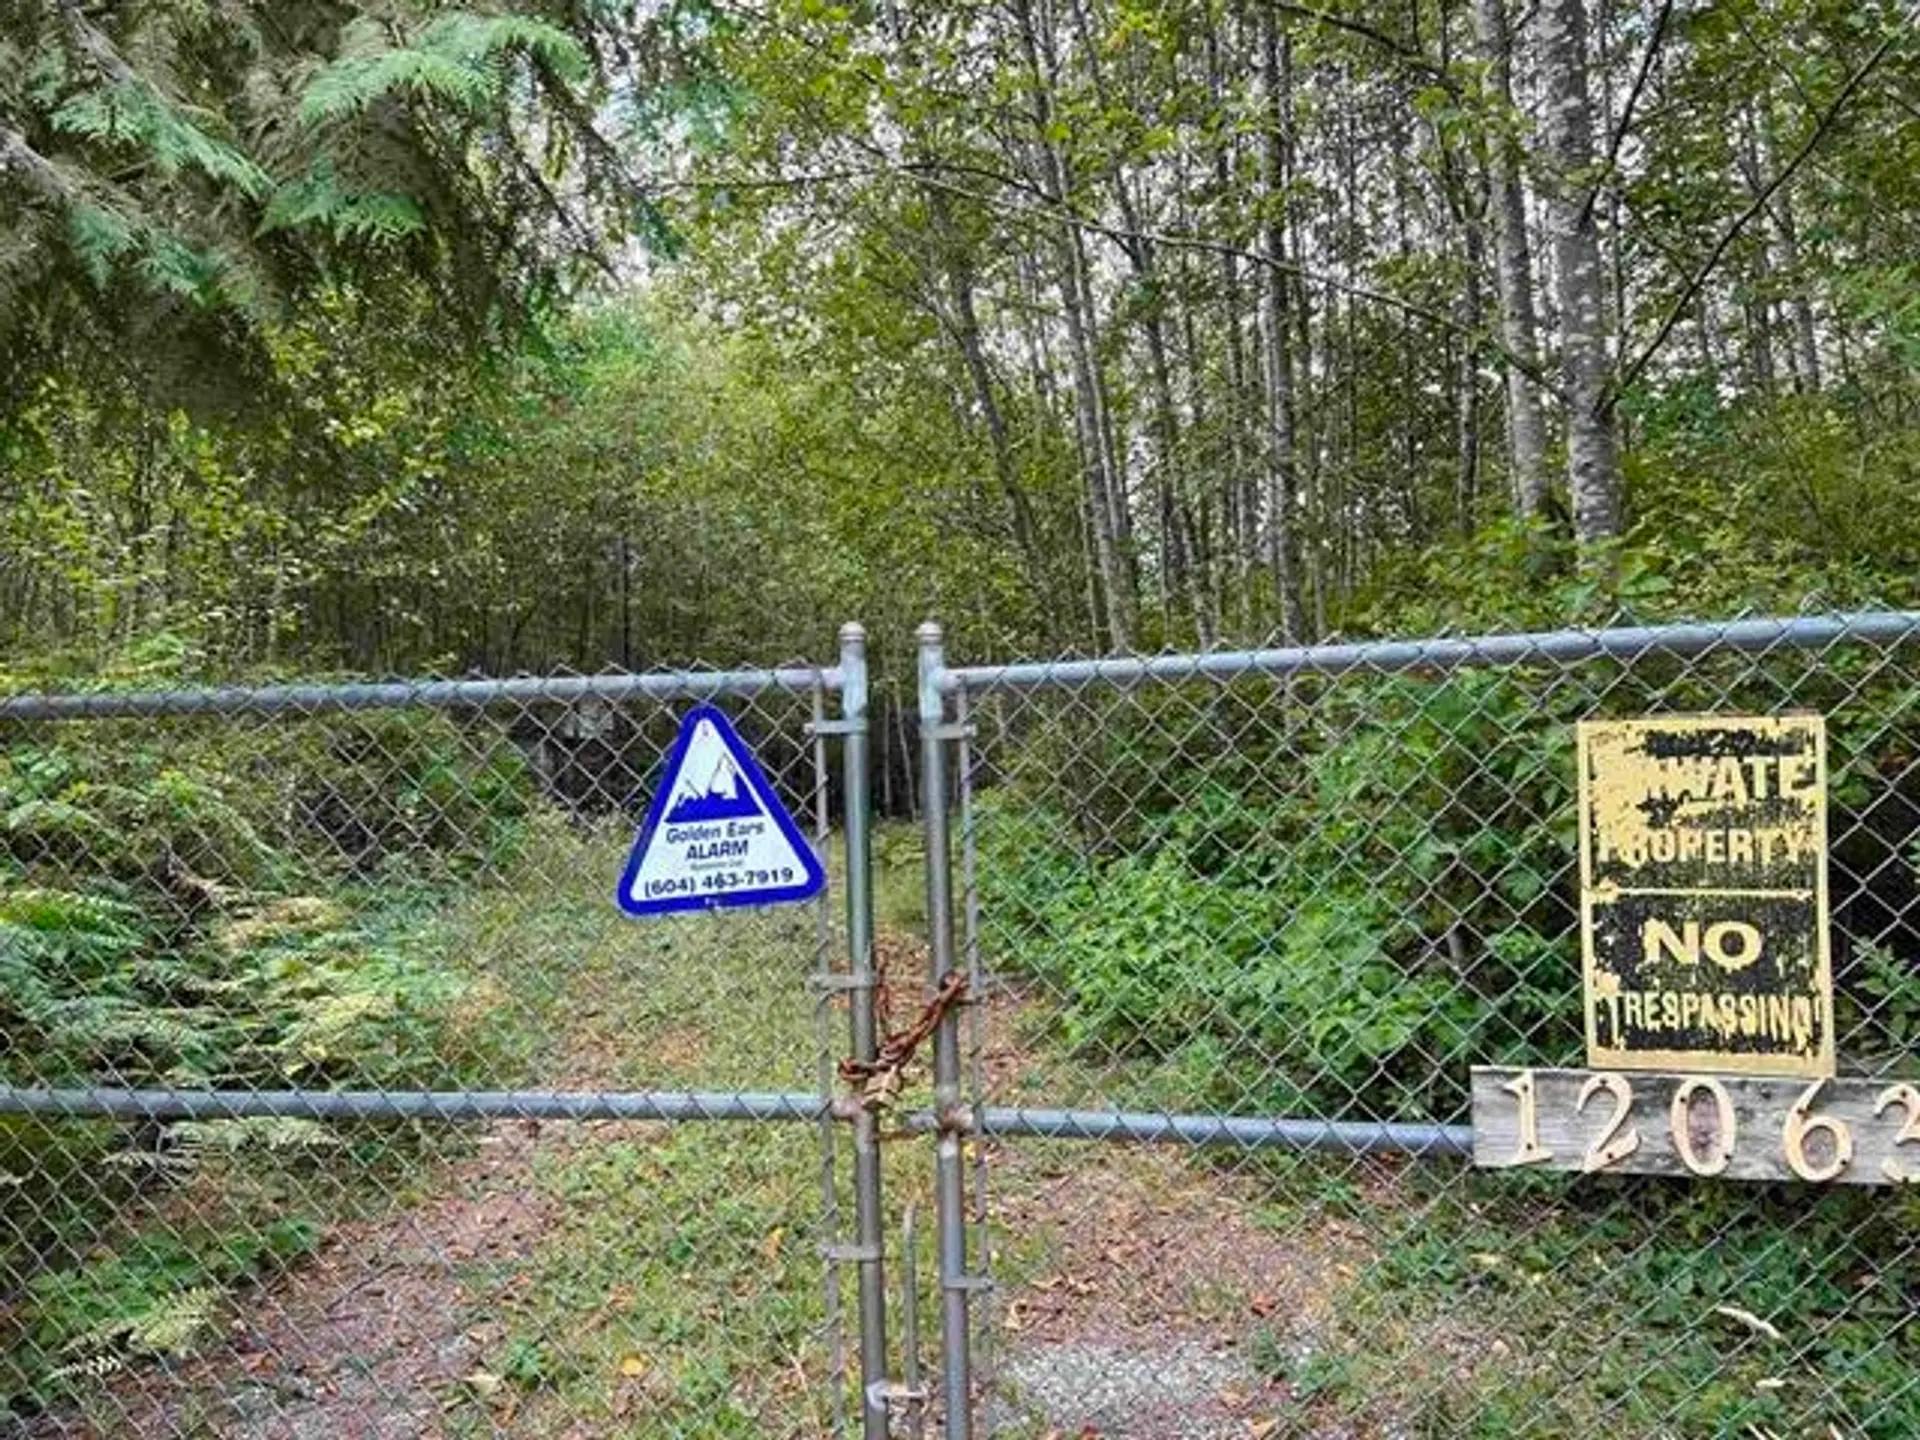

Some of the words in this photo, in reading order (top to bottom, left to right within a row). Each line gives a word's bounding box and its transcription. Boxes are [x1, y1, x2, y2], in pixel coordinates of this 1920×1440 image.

[666, 825, 721, 844] Golden
[726, 821, 765, 838] Ears
[686, 839, 748, 861] ALARM
[644, 876, 695, 898] (604)
[701, 866, 794, 889] 463-7919
[1641, 918, 1763, 972] NO
